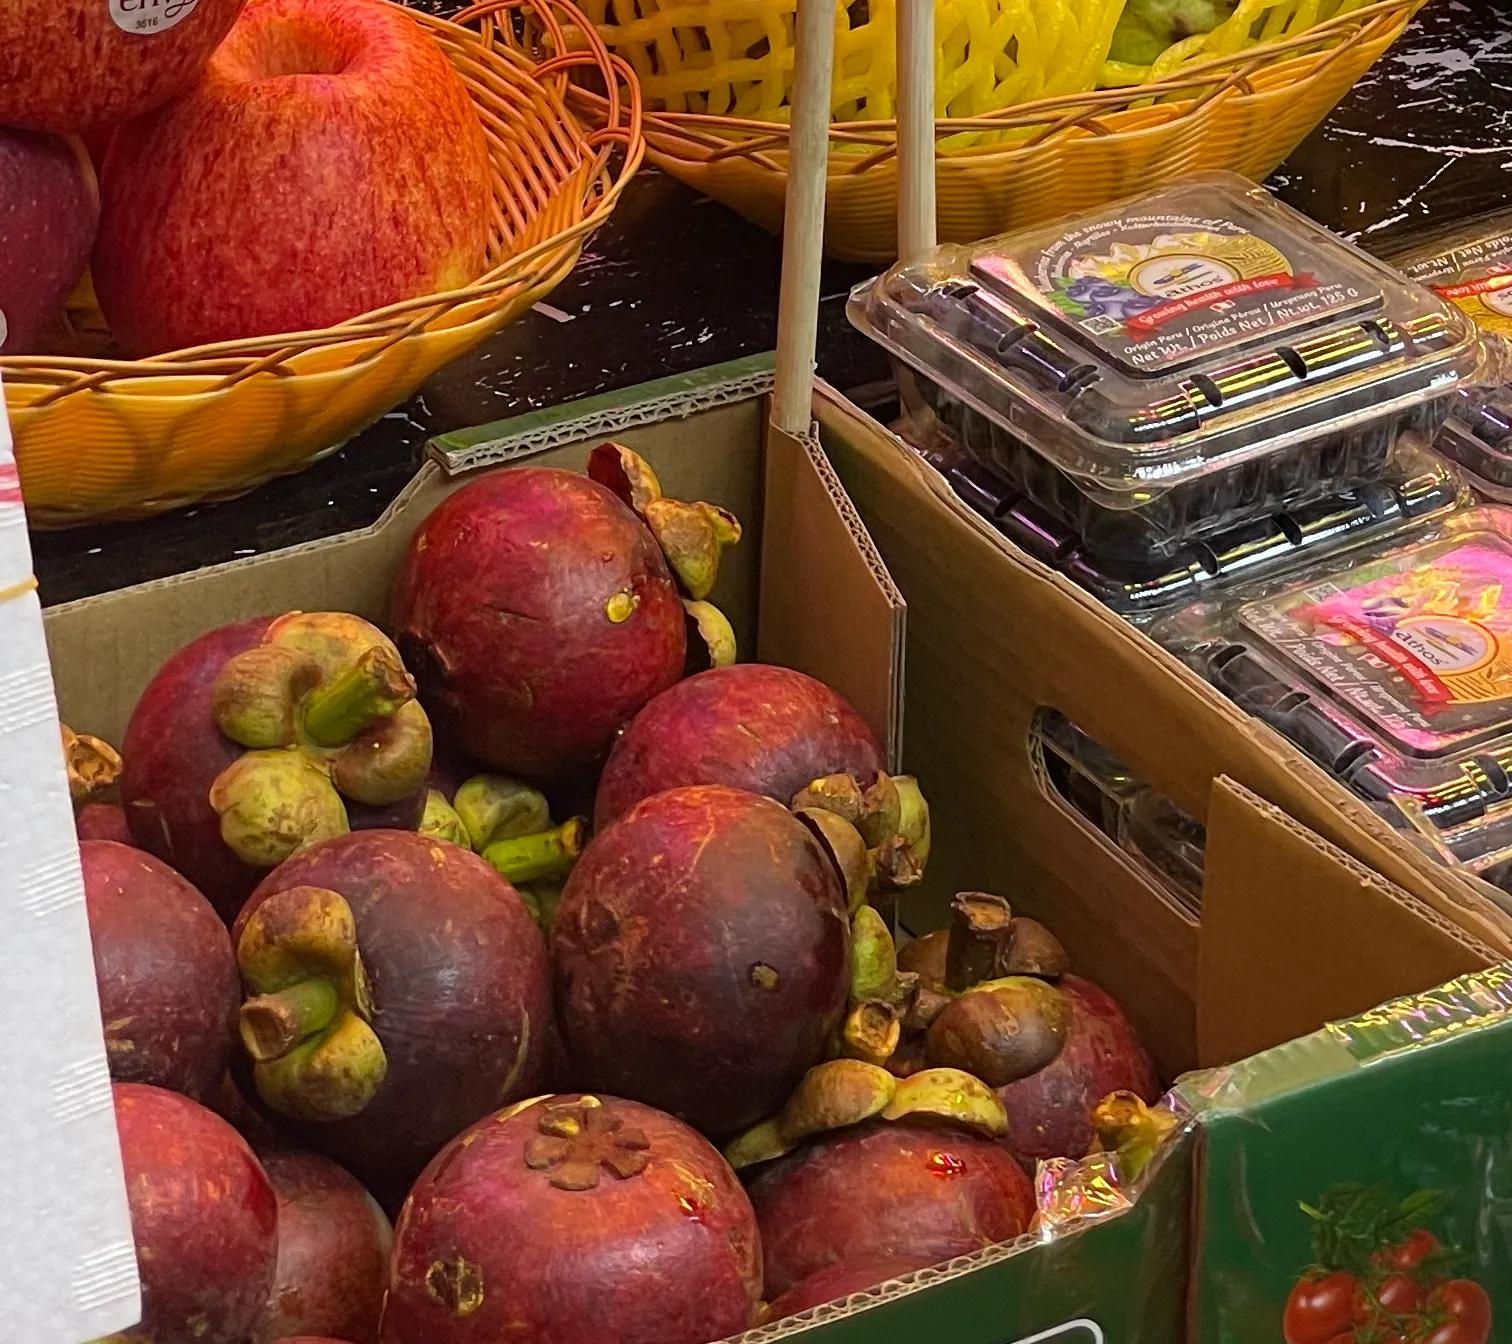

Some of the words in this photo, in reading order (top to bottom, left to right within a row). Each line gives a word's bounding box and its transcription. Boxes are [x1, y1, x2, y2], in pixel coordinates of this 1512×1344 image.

[1459, 244, 1485, 259] Net
[1164, 273, 1222, 299] athos
[1124, 340, 1158, 355] Origin
[1158, 331, 1184, 344] Peru
[1192, 317, 1231, 333] Origine
[1318, 282, 1344, 295] Peru
[1131, 349, 1161, 367] Net
[1199, 326, 1238, 345] Poids
[1238, 317, 1268, 333] Net
[1320, 291, 1346, 307] 125
[1394, 631, 1442, 666] athos
